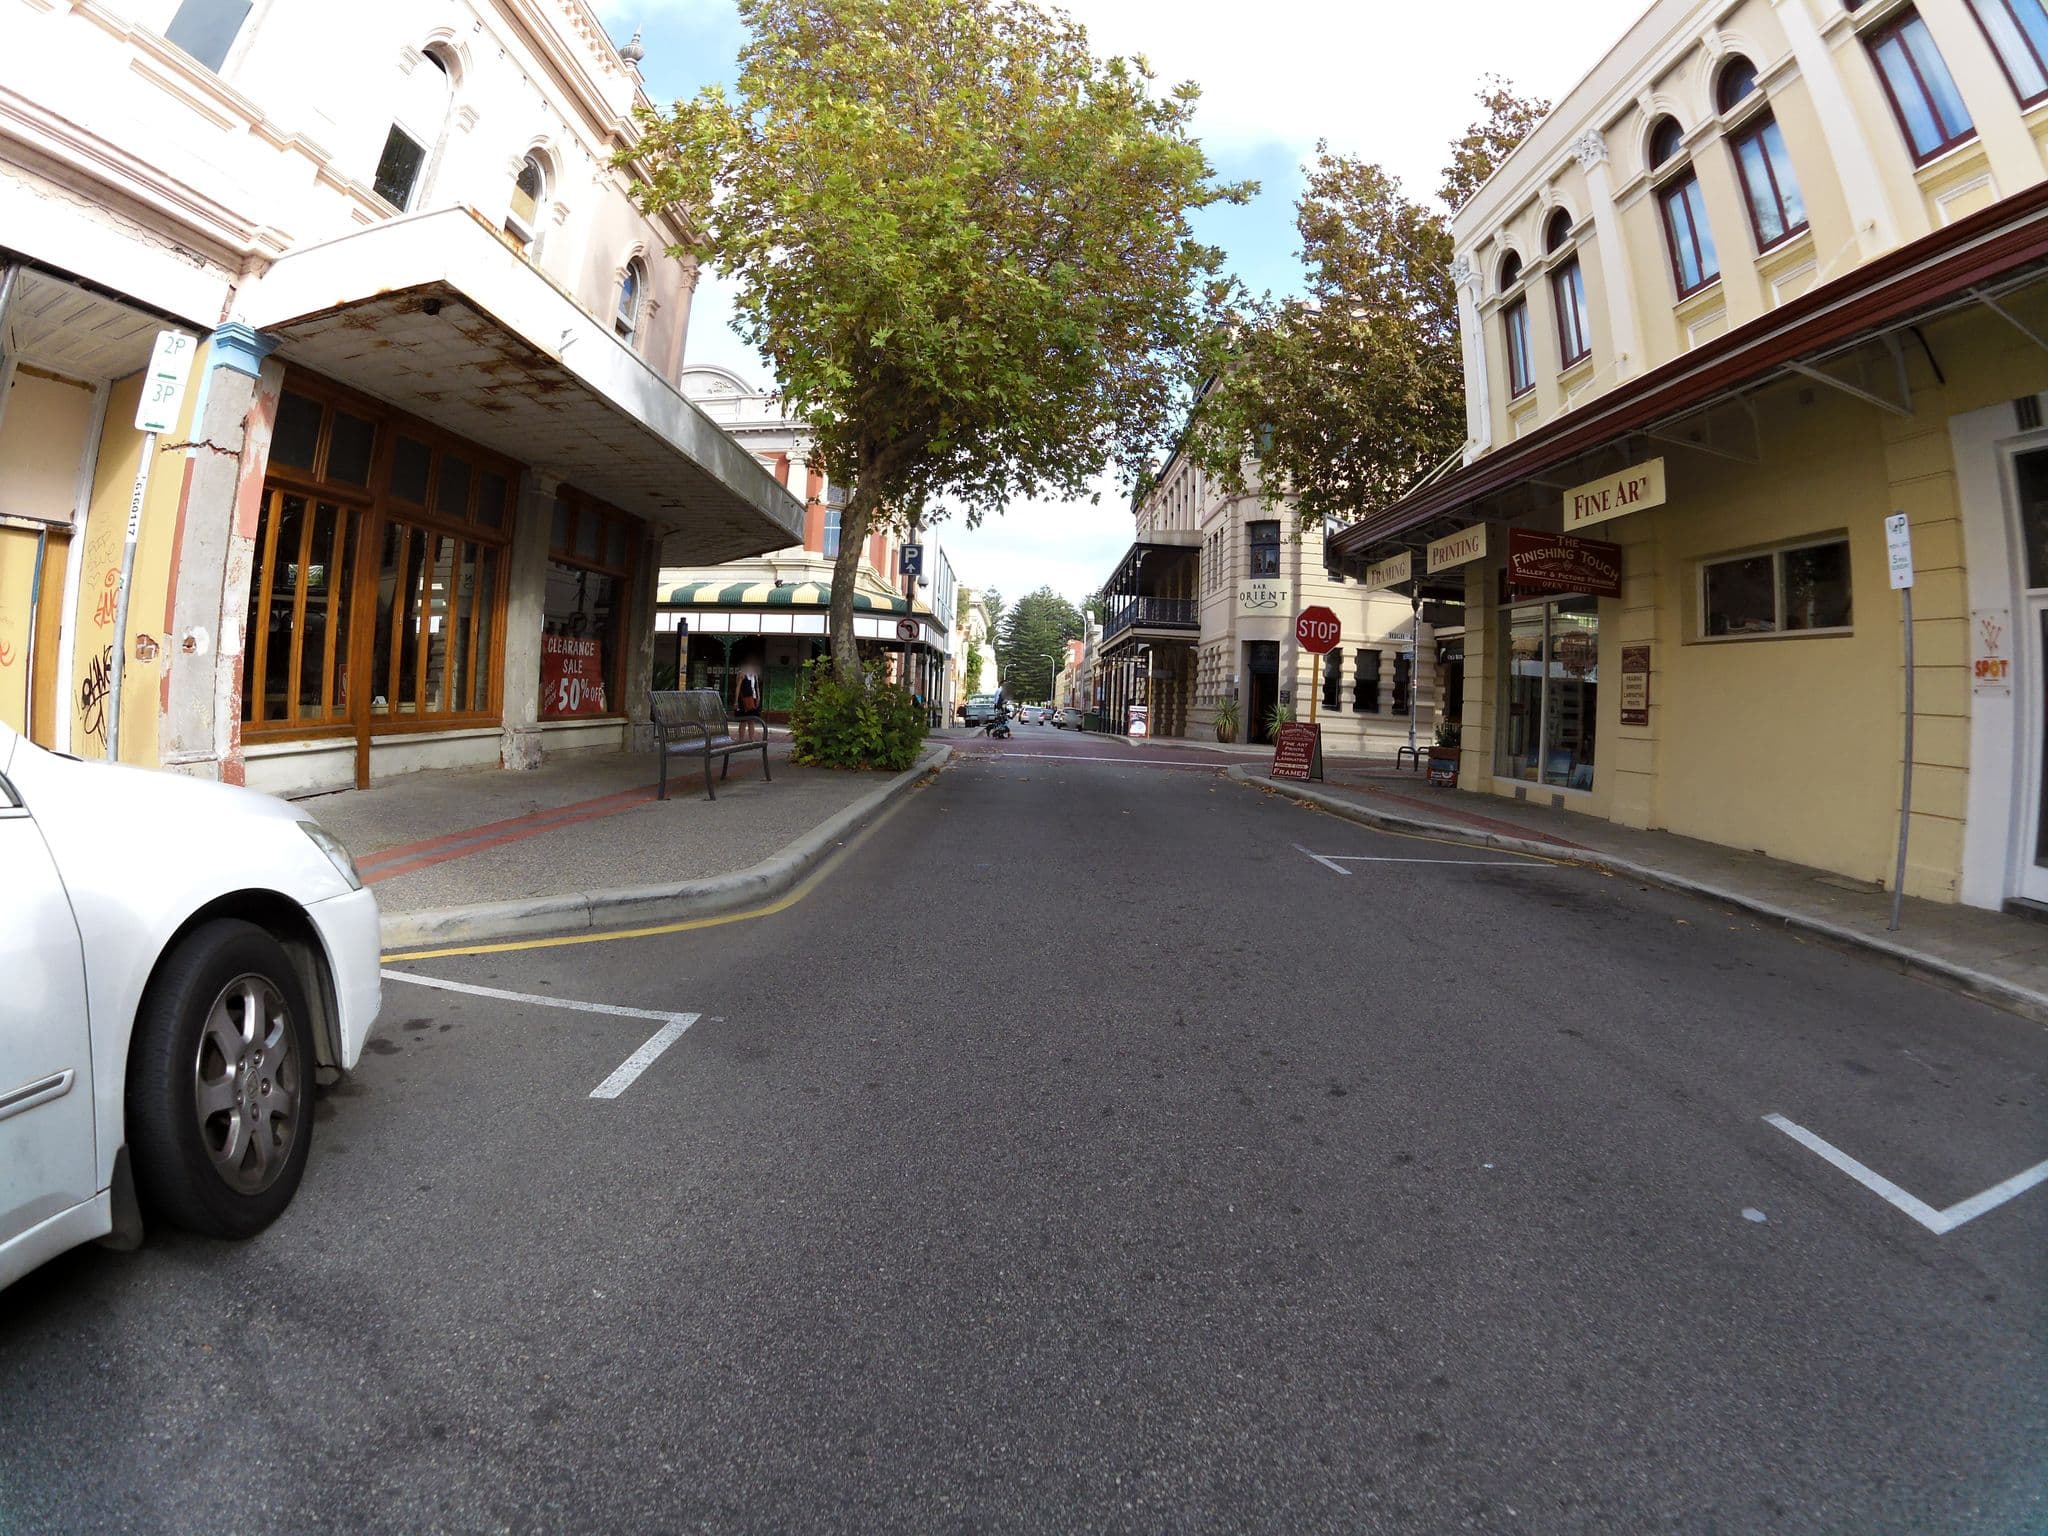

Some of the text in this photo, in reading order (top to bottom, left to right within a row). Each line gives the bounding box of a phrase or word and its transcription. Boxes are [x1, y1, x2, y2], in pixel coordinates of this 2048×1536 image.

[164, 336, 186, 355] 2P
[152, 383, 175, 404] 3P
[1574, 487, 1611, 520] FINE
[1432, 536, 1479, 566] PRINTING
[1556, 535, 1580, 548] THE
[905, 547, 918, 563] P
[1512, 548, 1619, 581] FINISHING TOUCH
[1371, 563, 1406, 586] FRAMING
[1516, 567, 1547, 576] GALLERY
[1558, 573, 1586, 582] PICTURE
[1240, 591, 1287, 604] ORIENT
[1298, 619, 1338, 640] STOP
[547, 638, 595, 657] CLEARANCE
[562, 658, 583, 674] SALE
[1975, 659, 2008, 678] SPOT
[1273, 768, 1308, 777] FRAMER
